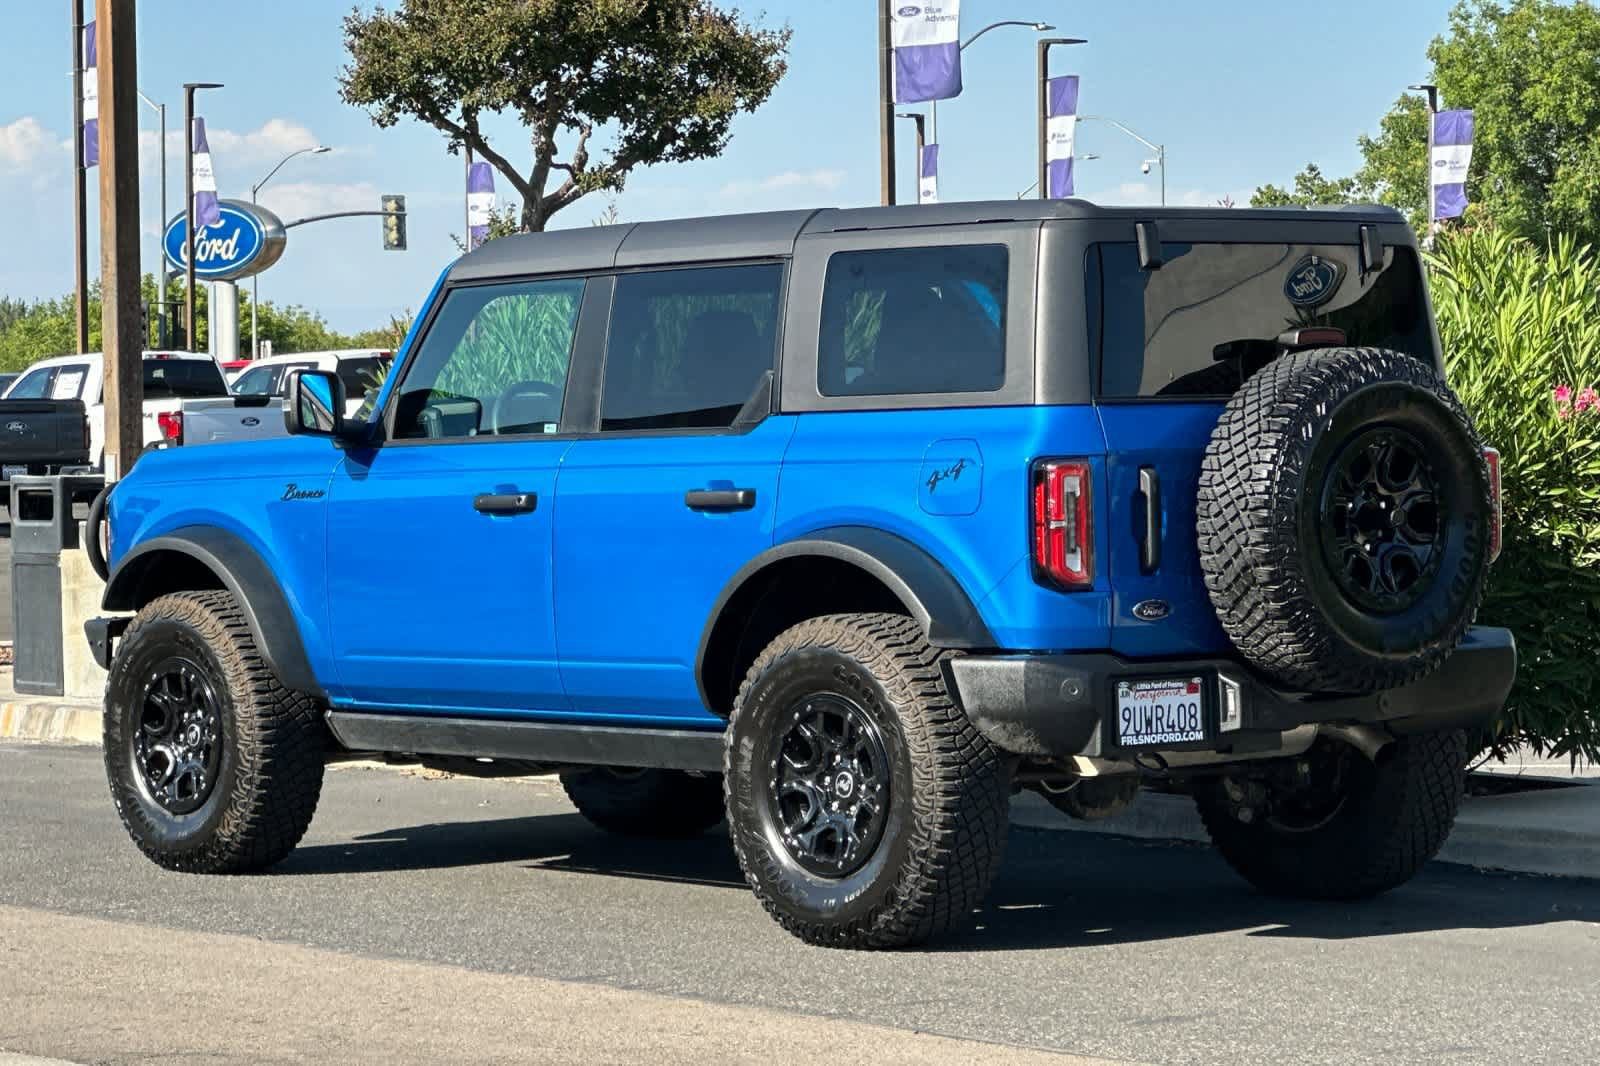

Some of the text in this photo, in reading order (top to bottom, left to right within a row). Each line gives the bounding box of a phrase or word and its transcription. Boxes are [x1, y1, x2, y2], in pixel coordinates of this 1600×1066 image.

[280, 483, 326, 501] Bronco
[1122, 702, 1198, 735] 9UWR408
[1121, 730, 1203, 746] FRESNOFORD.COM
